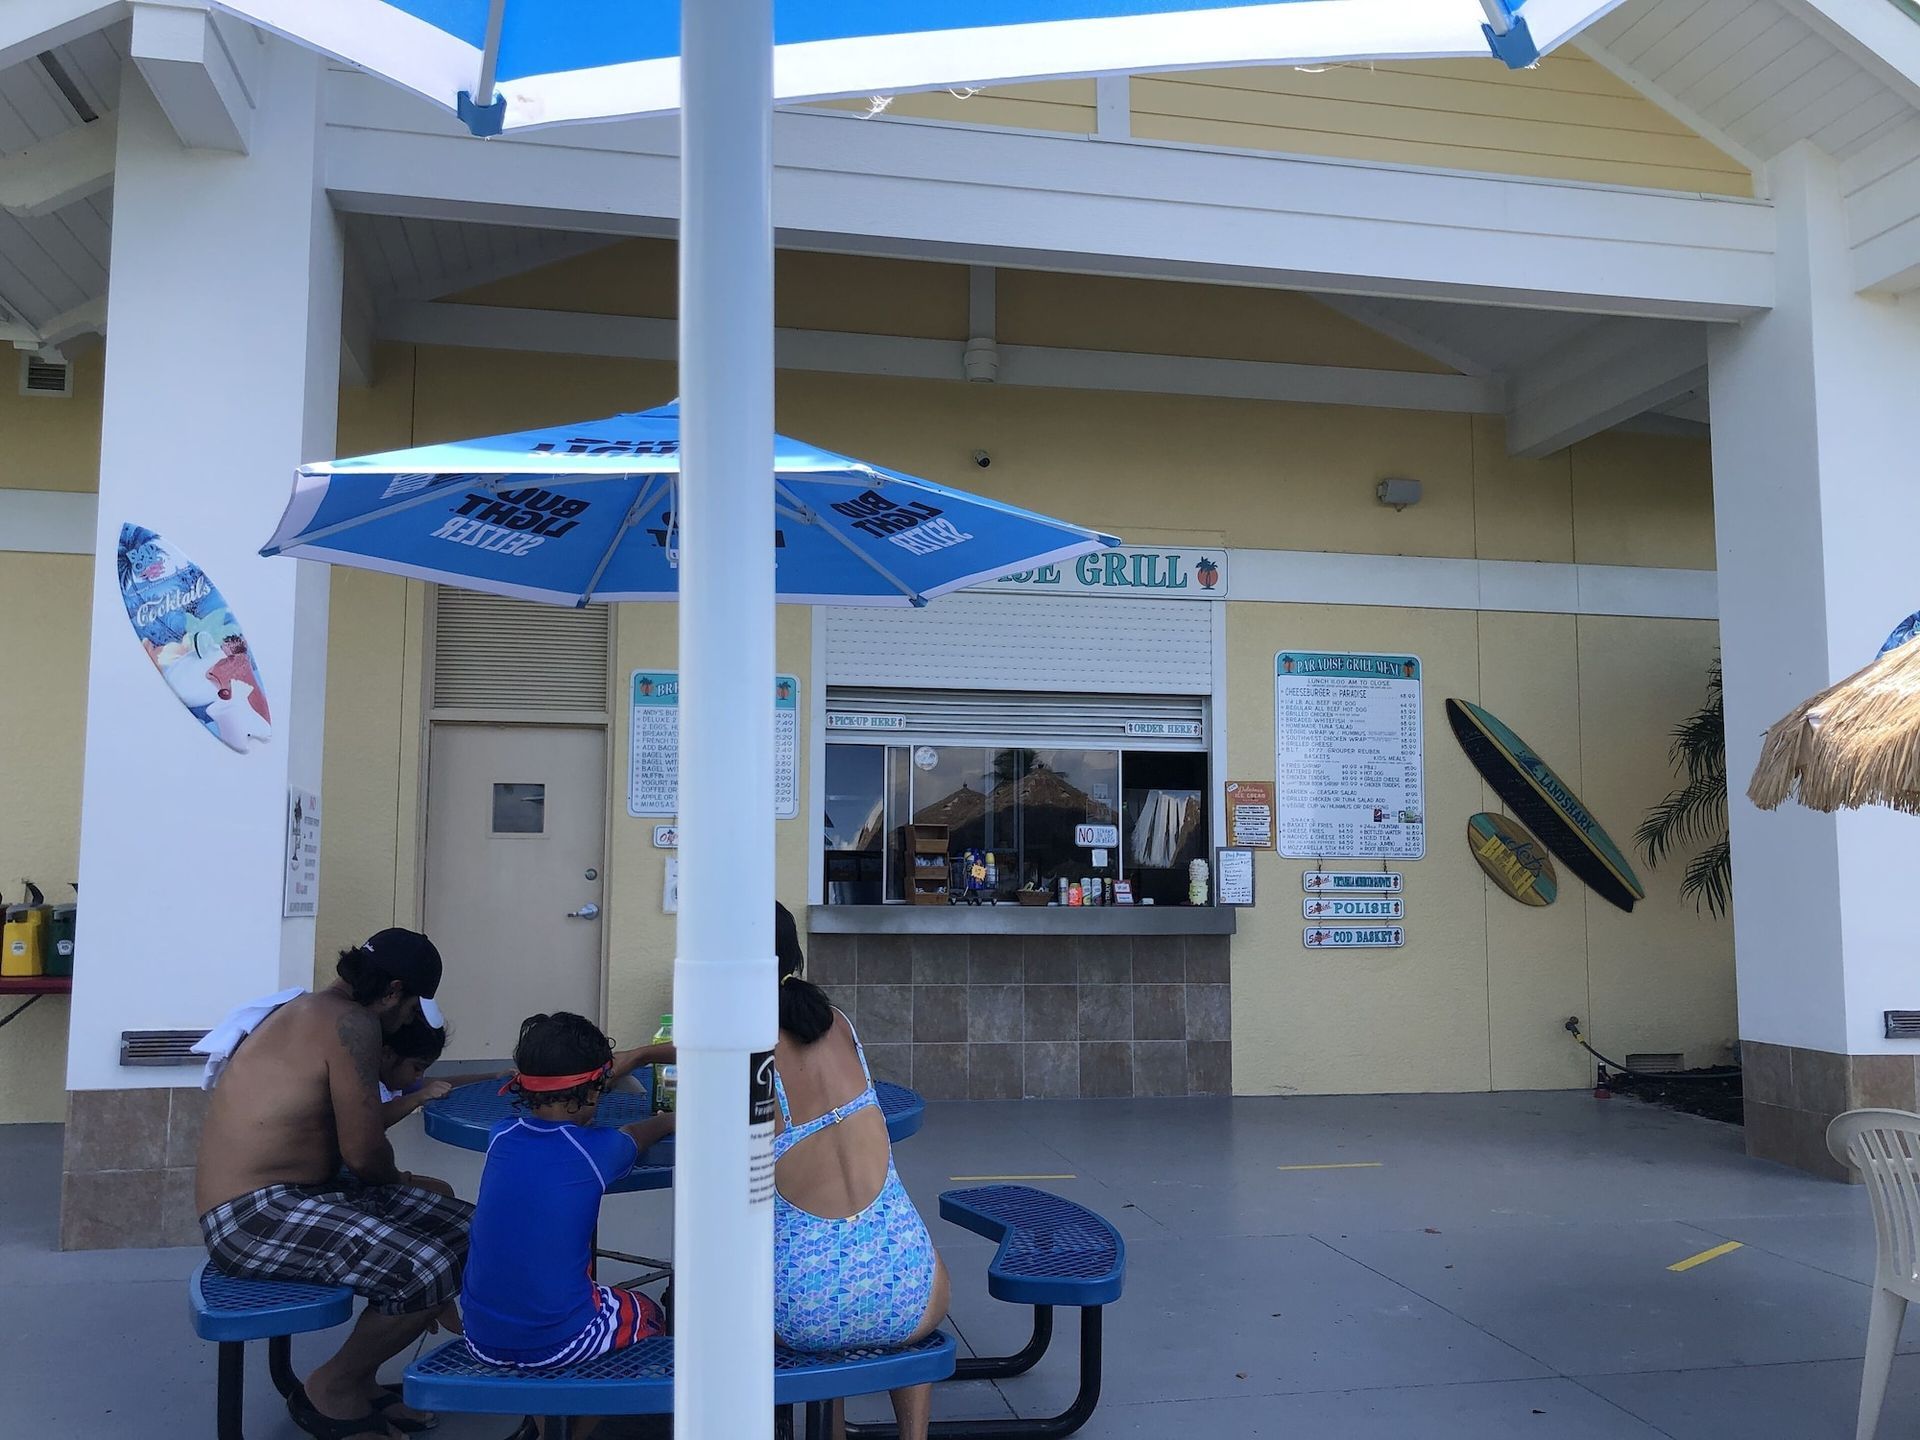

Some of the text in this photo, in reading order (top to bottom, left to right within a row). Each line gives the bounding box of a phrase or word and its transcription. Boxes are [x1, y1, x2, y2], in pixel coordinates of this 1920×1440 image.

[1075, 552, 1187, 589] GRILL
[137, 575, 211, 626] Cocktails
[1297, 657, 1344, 674] PARADISE
[1346, 658, 1373, 673] GRILL
[1285, 687, 1331, 697] CHEESEBURGER
[1339, 689, 1367, 698] PARADISE
[834, 716, 897, 727] PICK-UP HERE
[1133, 723, 1193, 734] ORDER HERE
[1539, 772, 1595, 834] LANDSHARK
[1078, 827, 1094, 843] NO
[1333, 902, 1391, 914] POLISH
[1333, 931, 1353, 943] COD
[1355, 931, 1393, 943] BASKET
